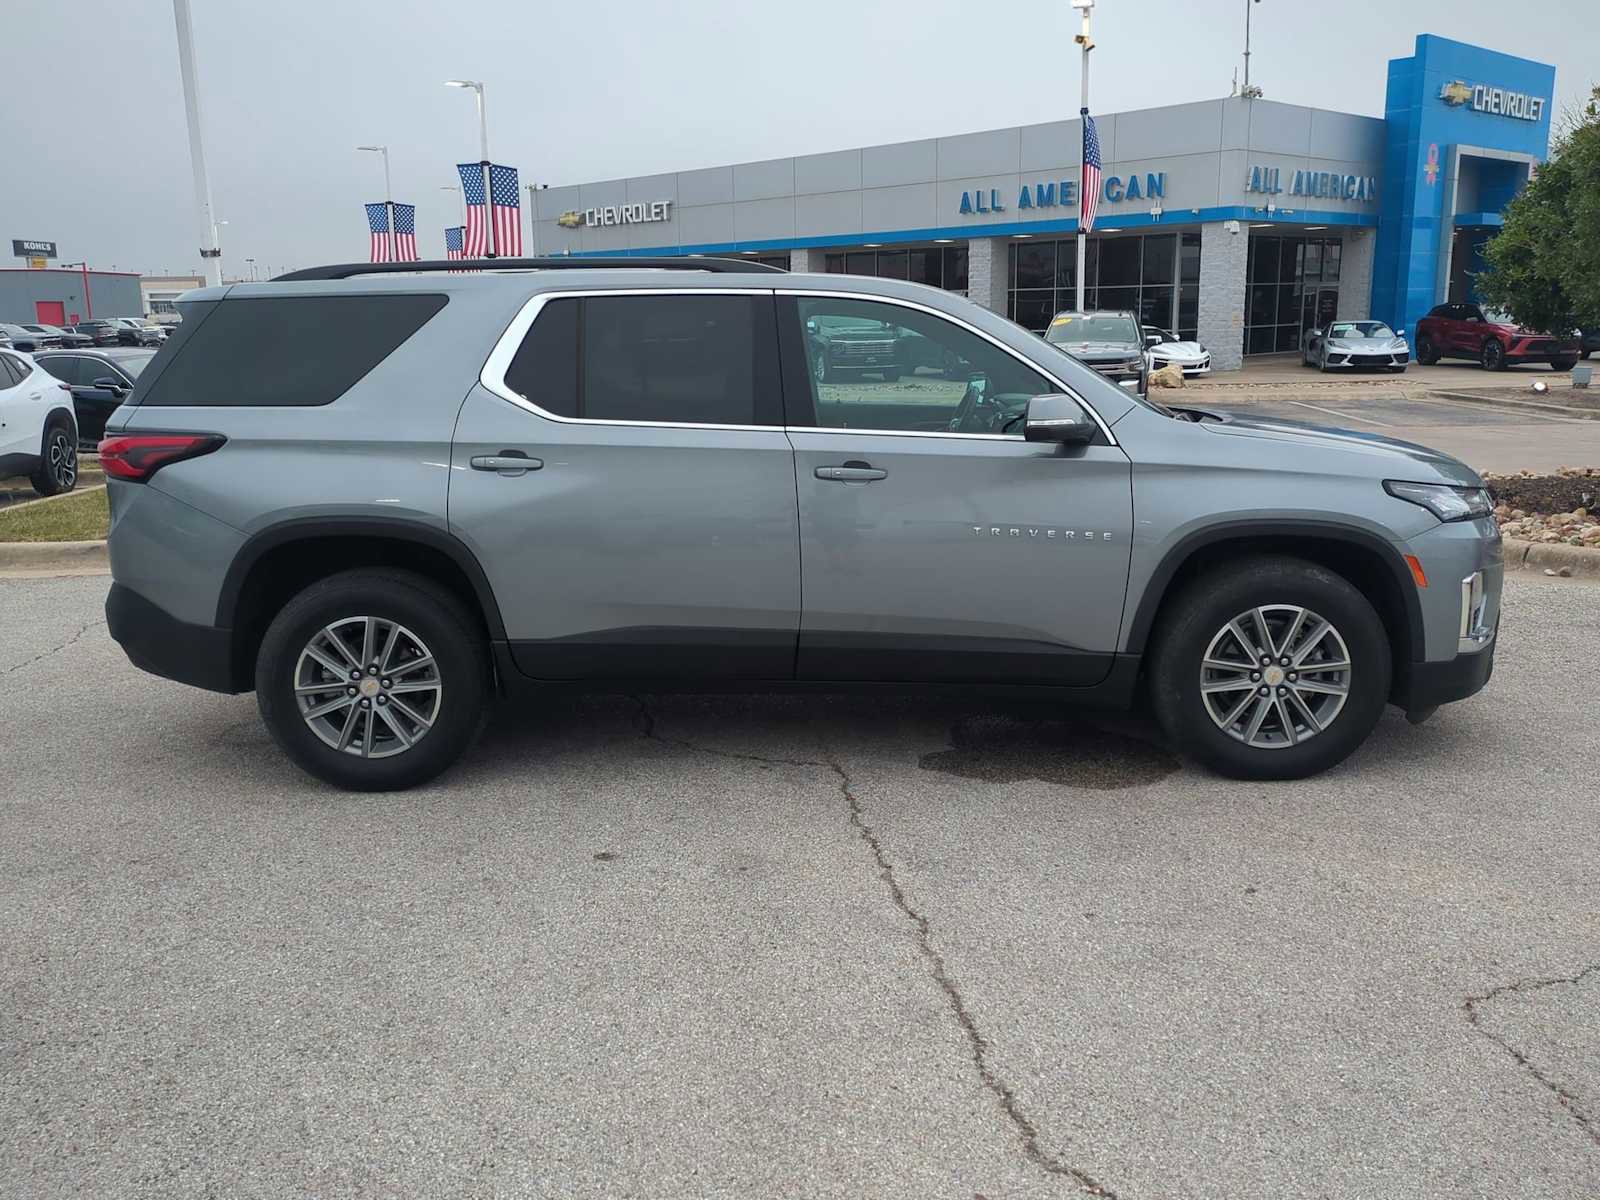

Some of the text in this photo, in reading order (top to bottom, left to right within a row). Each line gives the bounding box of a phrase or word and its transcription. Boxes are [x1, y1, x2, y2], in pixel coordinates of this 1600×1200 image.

[1474, 85, 1545, 120] CHEVROLET
[960, 172, 1166, 214] ALL AMECAN
[1246, 166, 1376, 201] ALL AMERICAN
[585, 201, 670, 226] CHEVROLET
[973, 526, 1113, 541] TRAVERSE
